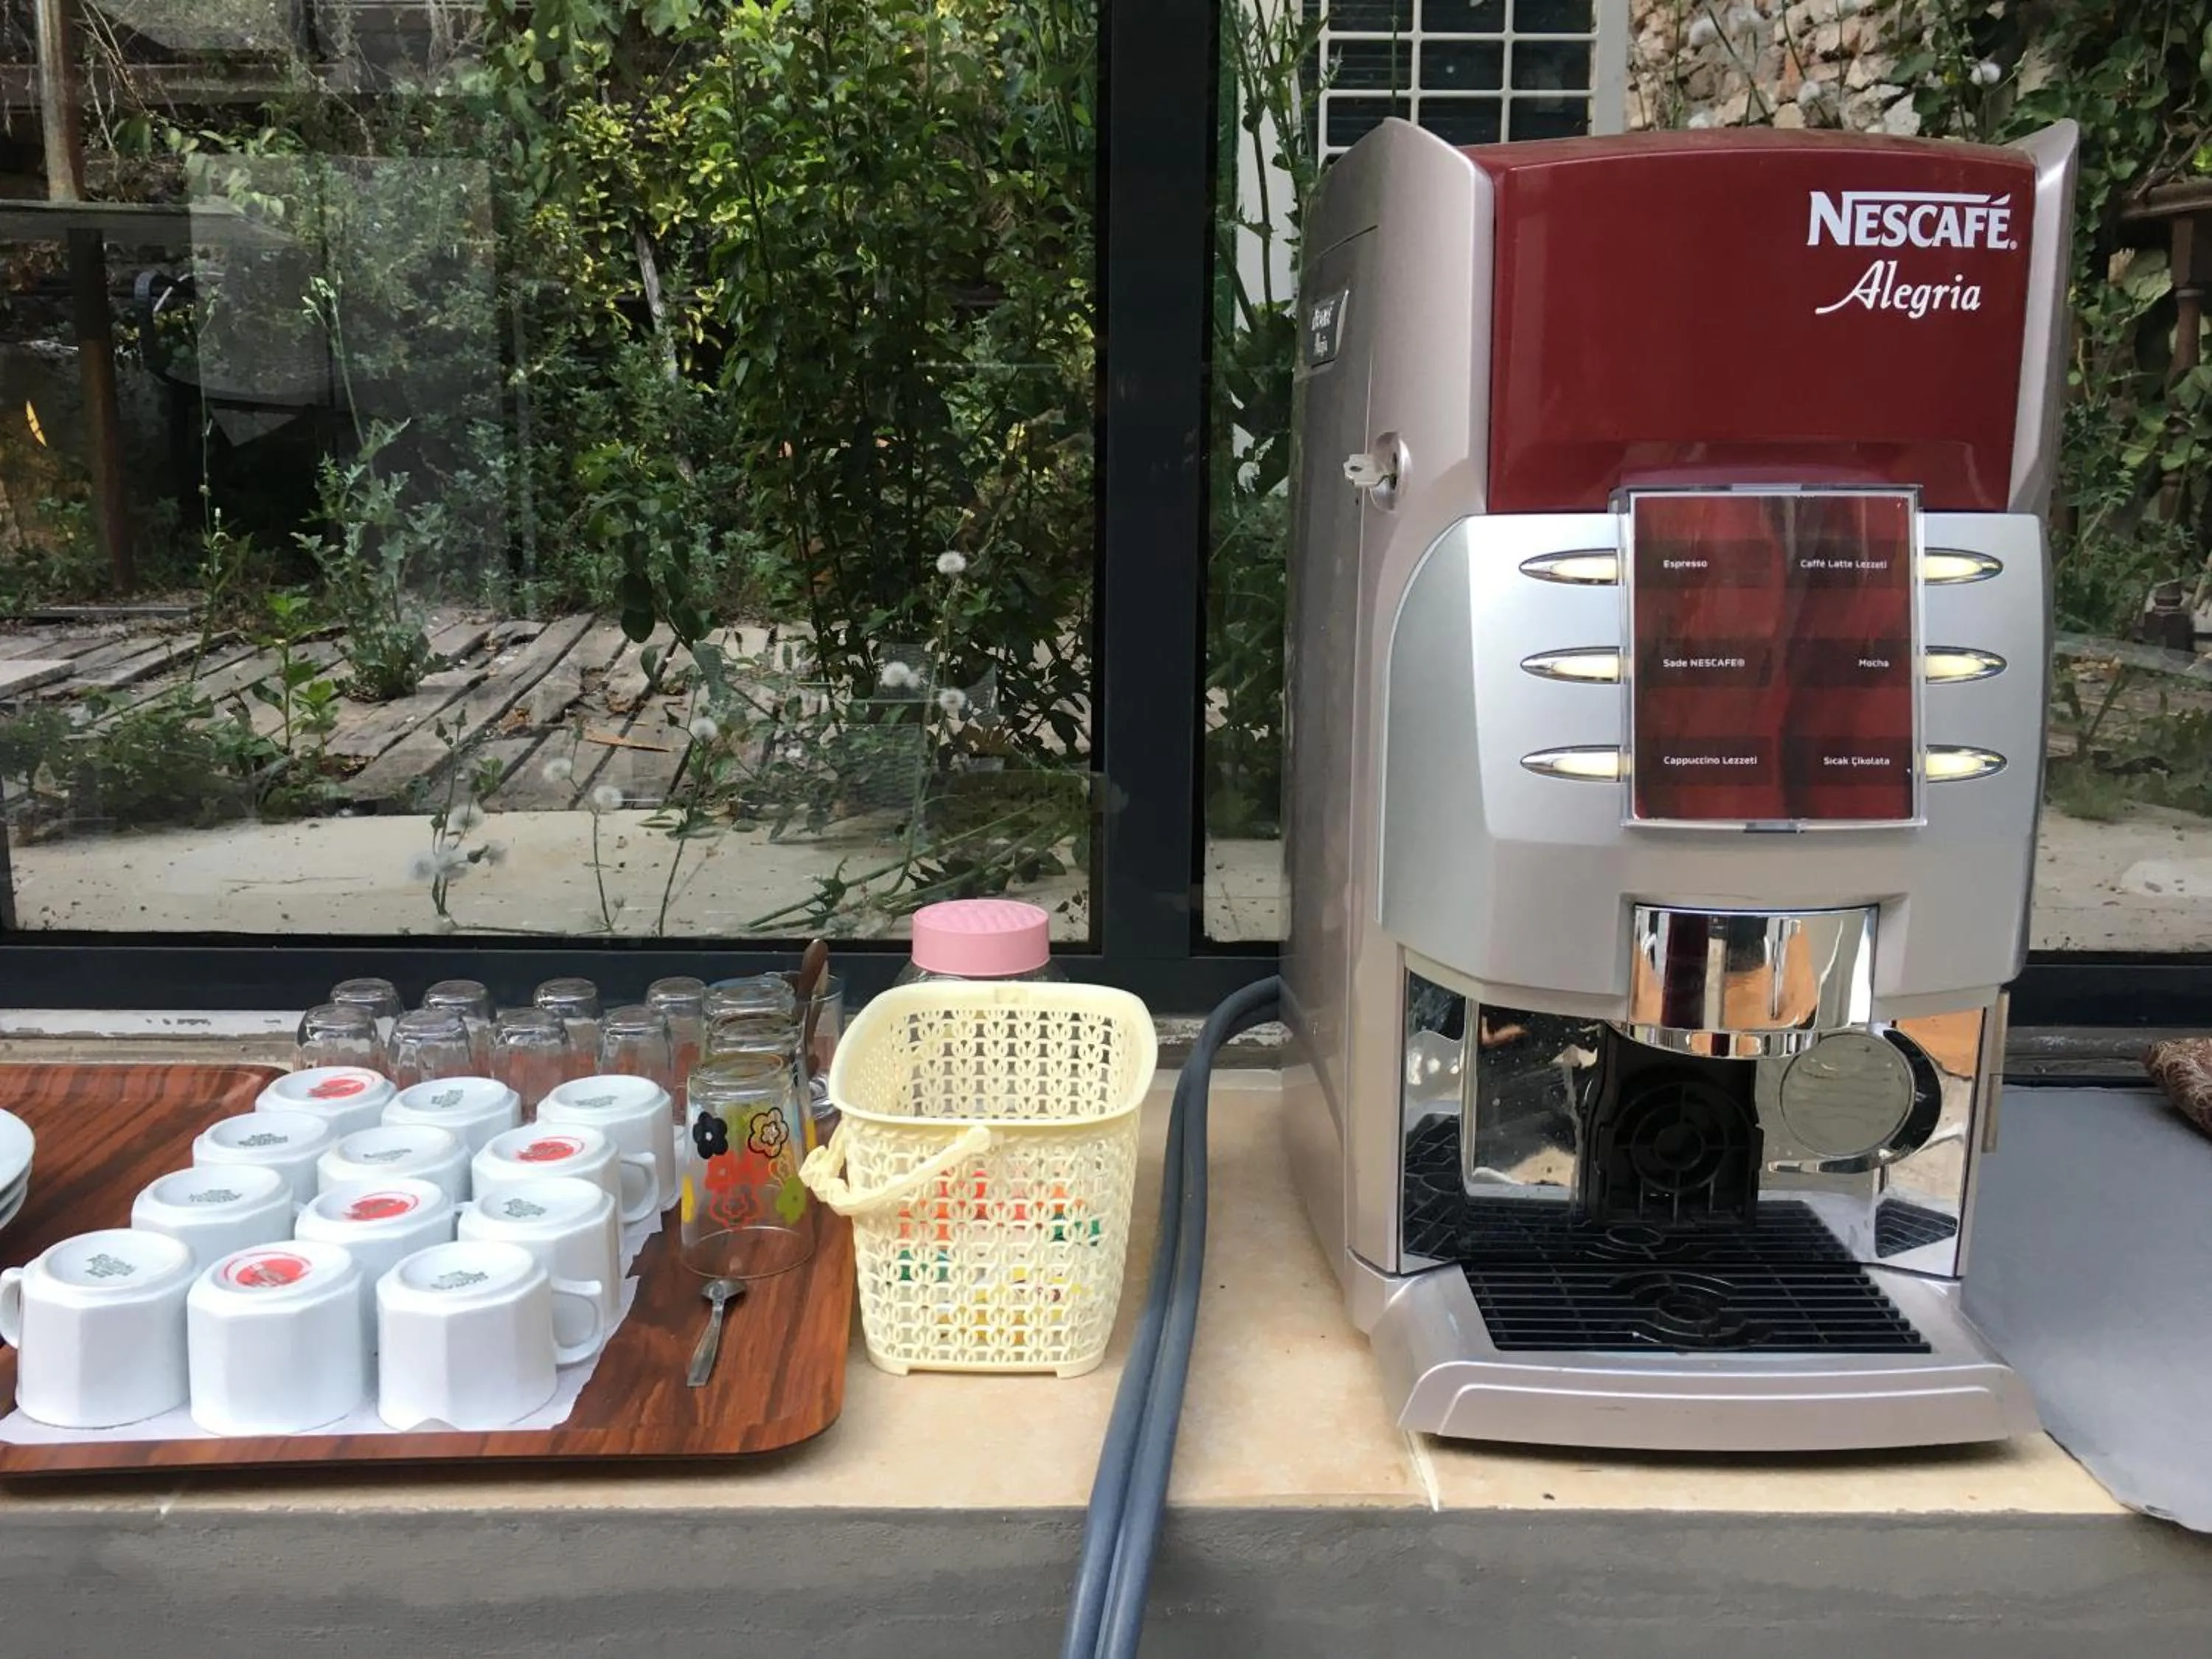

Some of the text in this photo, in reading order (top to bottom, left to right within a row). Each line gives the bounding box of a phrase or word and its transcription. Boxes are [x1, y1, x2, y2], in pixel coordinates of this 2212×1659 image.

[1815, 260, 1981, 319] Alegria
[1663, 560, 1708, 569] Espresso
[1828, 560, 1853, 568] Latte
[1663, 658, 1688, 667] Sade
[1858, 658, 1890, 667] Mocha
[1663, 756, 1758, 766] Cappuccino Lezzeti
[1851, 756, 1891, 767] Çikolata
